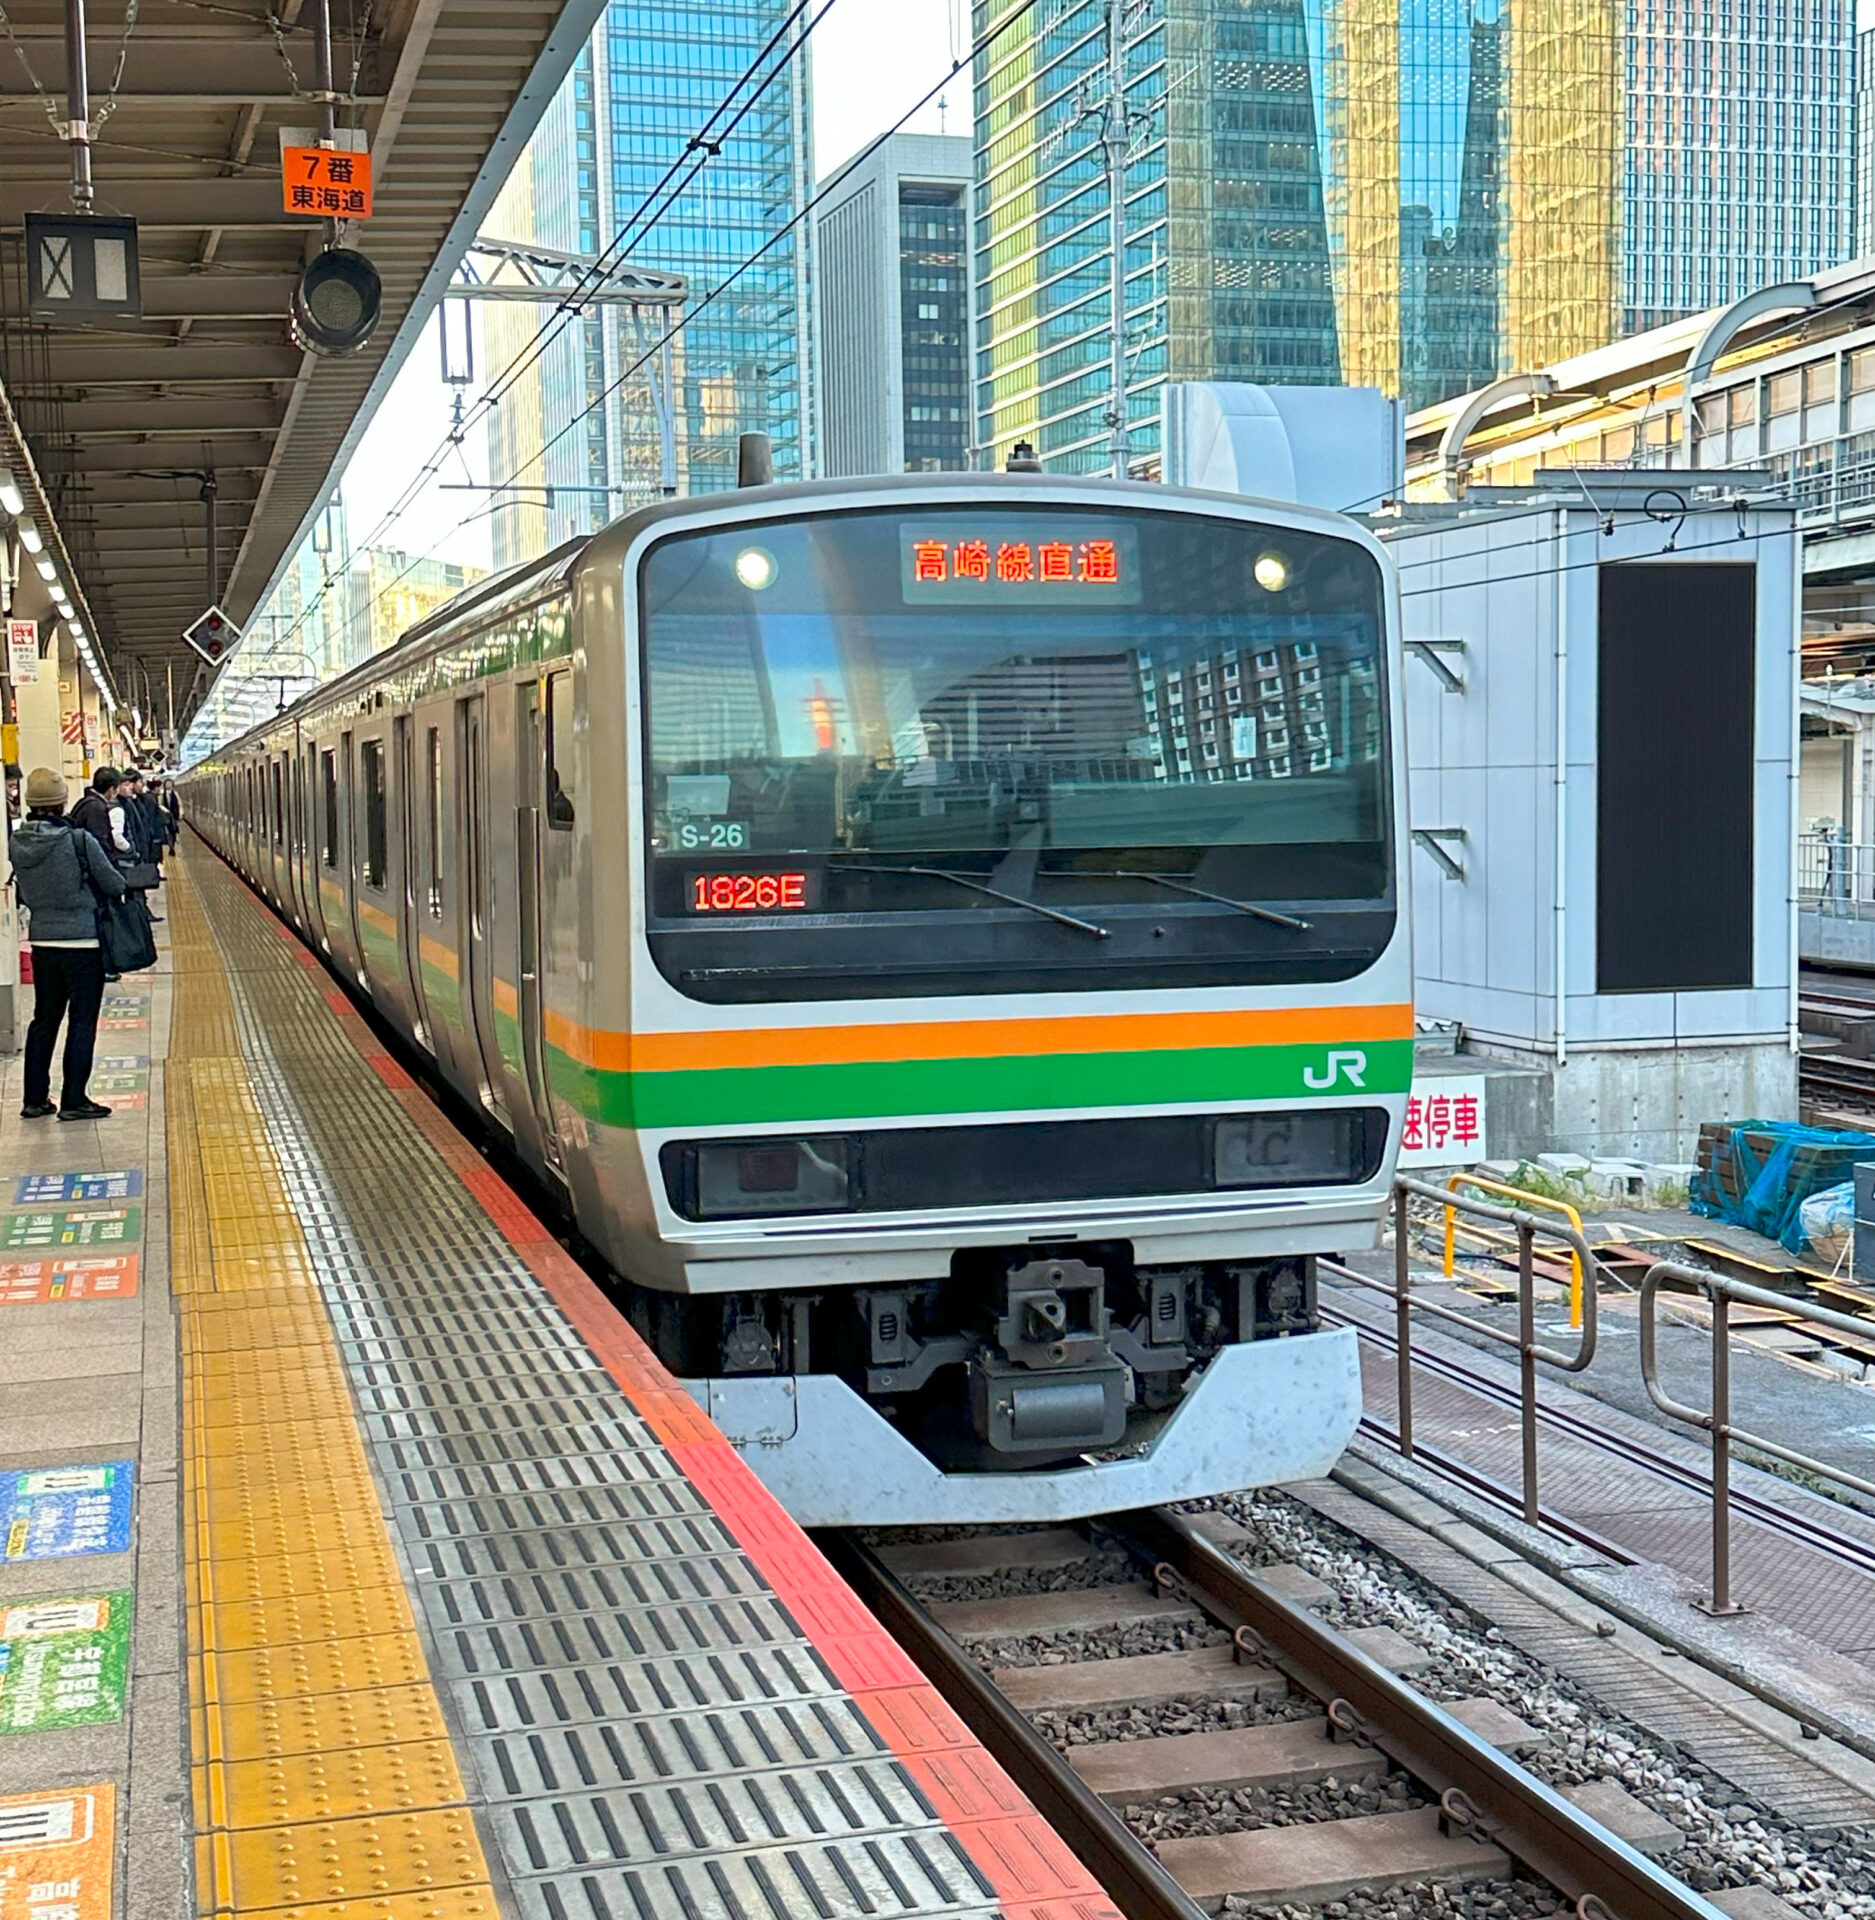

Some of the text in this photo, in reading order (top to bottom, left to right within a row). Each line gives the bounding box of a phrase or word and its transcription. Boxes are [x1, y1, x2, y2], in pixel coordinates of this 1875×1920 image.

[302, 155, 353, 184] 7番
[291, 184, 365, 213] 東海道
[913, 539, 1117, 583] 高崎線直通
[681, 824, 744, 848] S-26
[695, 874, 806, 911] 1826E
[1303, 1050, 1367, 1090] JR
